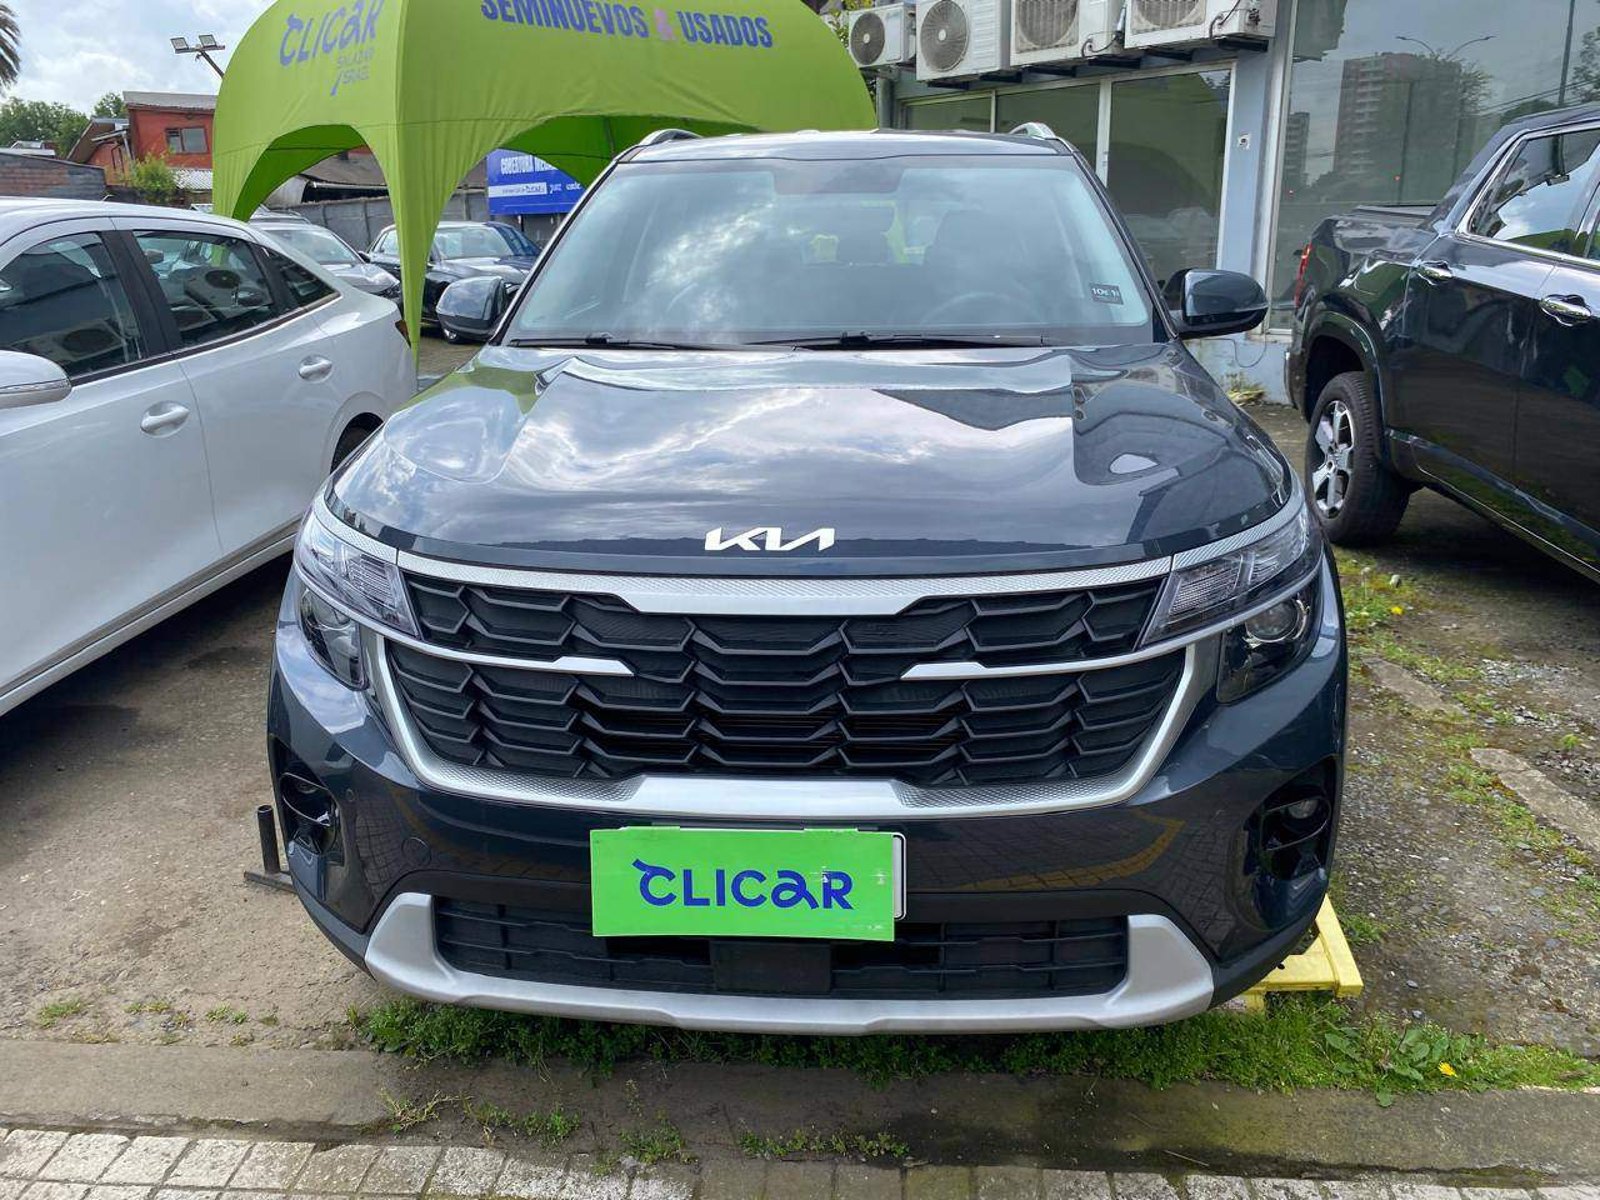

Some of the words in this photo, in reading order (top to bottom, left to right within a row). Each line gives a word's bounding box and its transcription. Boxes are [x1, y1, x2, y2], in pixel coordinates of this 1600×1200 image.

[481, 0, 650, 38] SEMINUEVOS
[677, 10, 773, 49] USADOS
[704, 527, 835, 551] KIA
